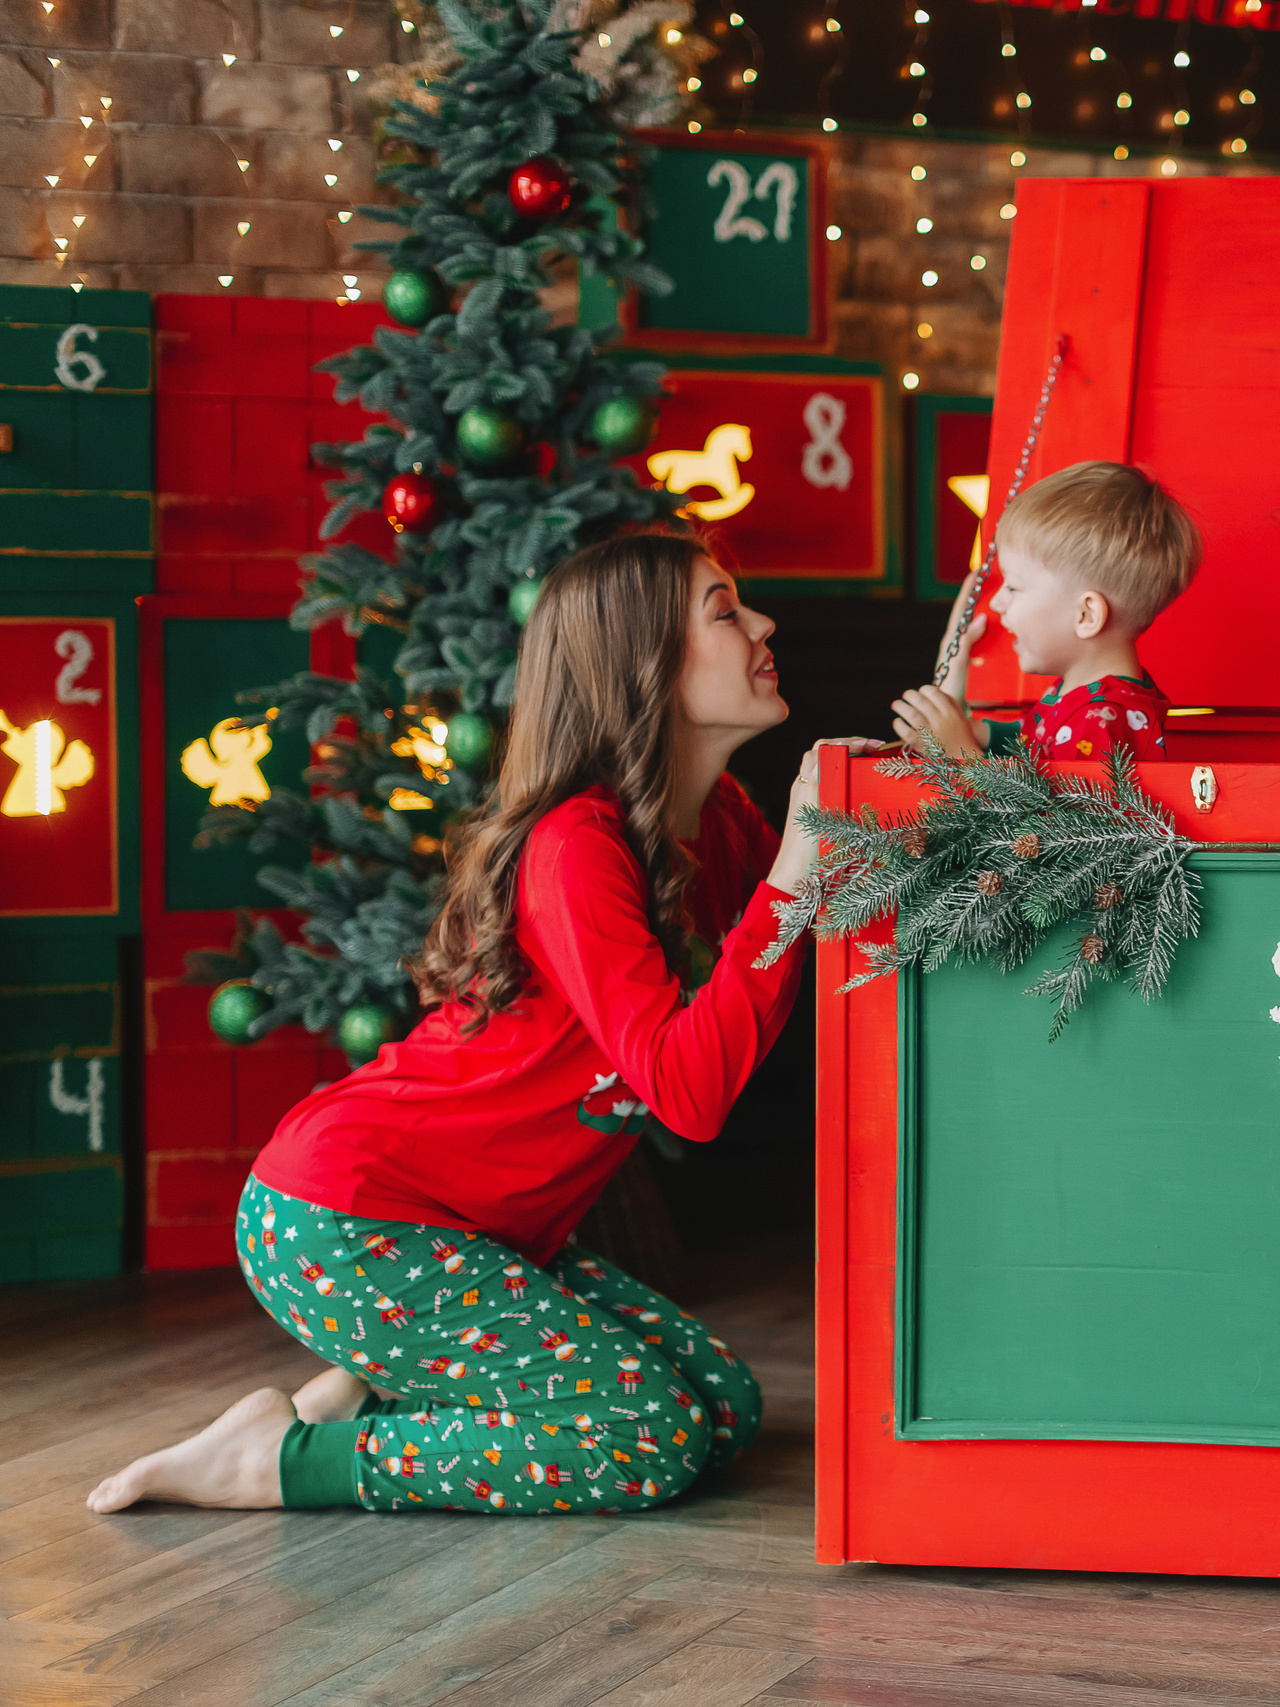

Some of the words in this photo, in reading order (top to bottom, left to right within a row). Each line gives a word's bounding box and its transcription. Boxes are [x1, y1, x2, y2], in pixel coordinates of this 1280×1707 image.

[54, 323, 107, 392] 6
[802, 391, 853, 492] 8
[55, 629, 102, 706] 2
[49, 1059, 104, 1151] 4
